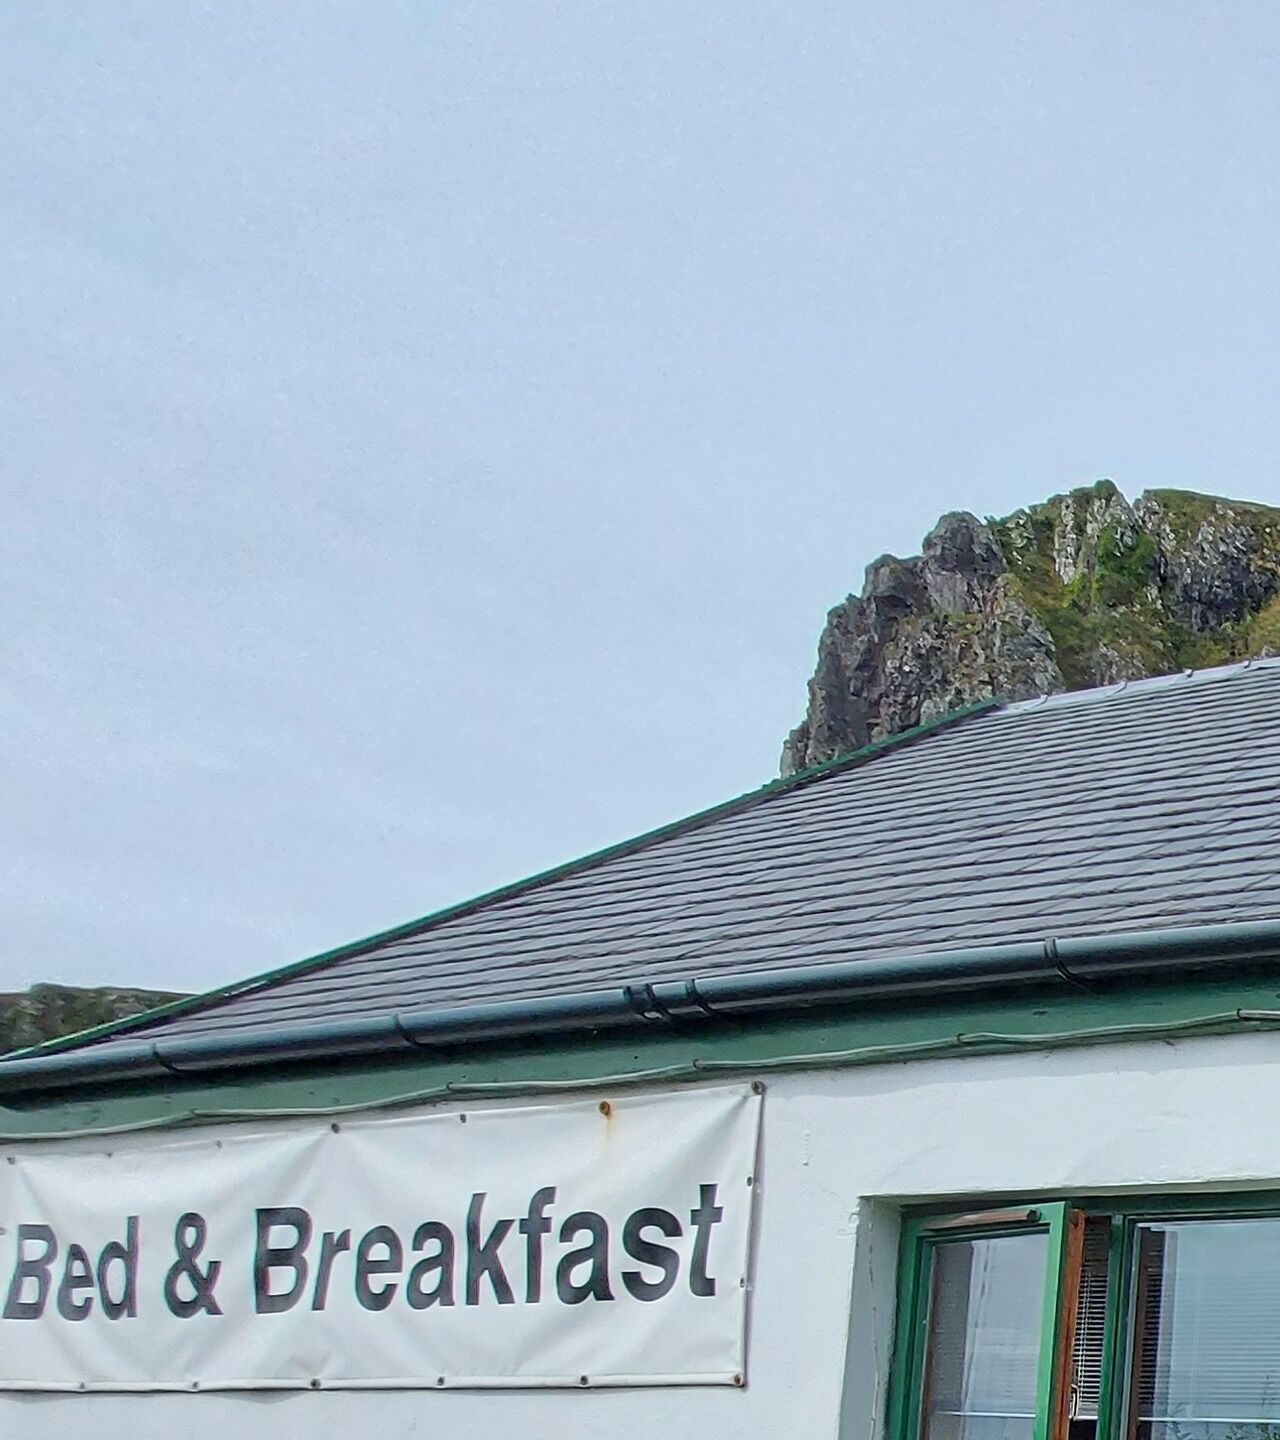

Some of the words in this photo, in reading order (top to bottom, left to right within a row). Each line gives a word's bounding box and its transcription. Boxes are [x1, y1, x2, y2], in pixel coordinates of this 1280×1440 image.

[2, 1215, 141, 1321] Bed
[164, 1211, 224, 1318] &
[254, 1183, 724, 1316] Breakfast
